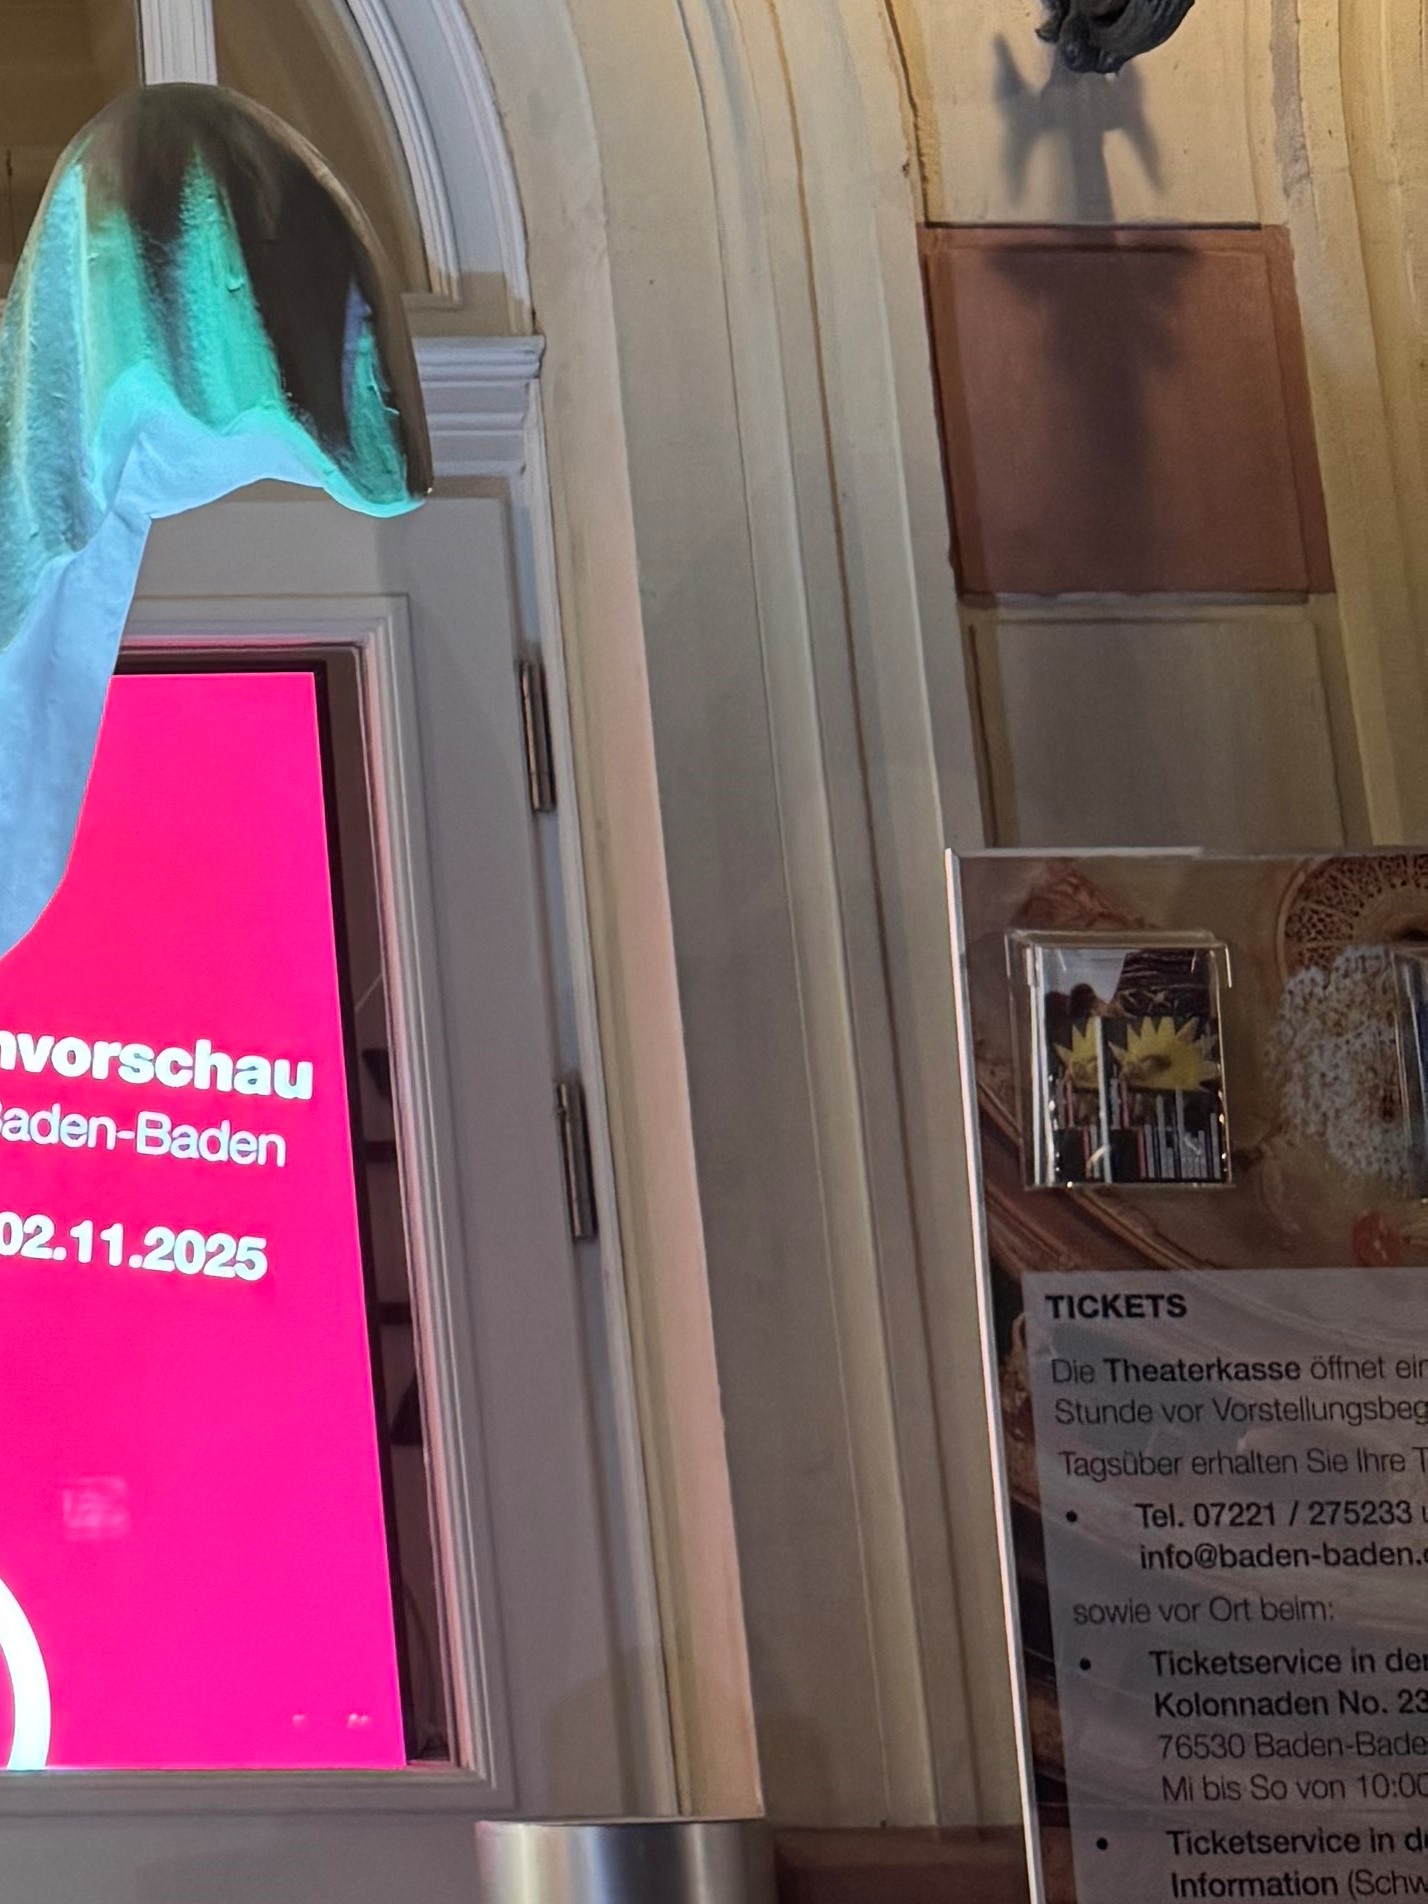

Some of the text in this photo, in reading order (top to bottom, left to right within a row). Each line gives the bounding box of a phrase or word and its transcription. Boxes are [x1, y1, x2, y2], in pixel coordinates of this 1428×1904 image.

[1045, 1294, 1187, 1319] TICKETS
[1051, 1358, 1095, 1384] Die
[1104, 1358, 1301, 1383] Theaterkasse
[1310, 1356, 1386, 1380] öffnet
[1055, 1399, 1152, 1424] Stunde
[1162, 1404, 1203, 1423] vor
[1058, 1450, 1180, 1482] Tagsüber
[1192, 1451, 1298, 1475] erhalten
[1307, 1449, 1348, 1474] Sie
[1358, 1448, 1405, 1473] Ihre
[1135, 1503, 1184, 1528] Tel.
[1194, 1502, 1276, 1527] 07221
[1288, 1502, 1297, 1526] /
[1308, 1501, 1413, 1526] 275233
[1073, 1597, 1335, 1624] sowie vor Ort beim:
[1149, 1648, 1341, 1676] Ticketservice
[1351, 1648, 1376, 1673] in
[1155, 1689, 1428, 1718] Kolonnaden No. 23
[1158, 1733, 1244, 1759] 76530
[1162, 1776, 1194, 1801] Mi
[1203, 1775, 1241, 1800] bis
[1251, 1774, 1288, 1799] So
[1297, 1777, 1344, 1798] von
[1166, 1828, 1360, 1855] Ticketservice
[1370, 1828, 1395, 1853] in
[1171, 1871, 1338, 1897] Information
